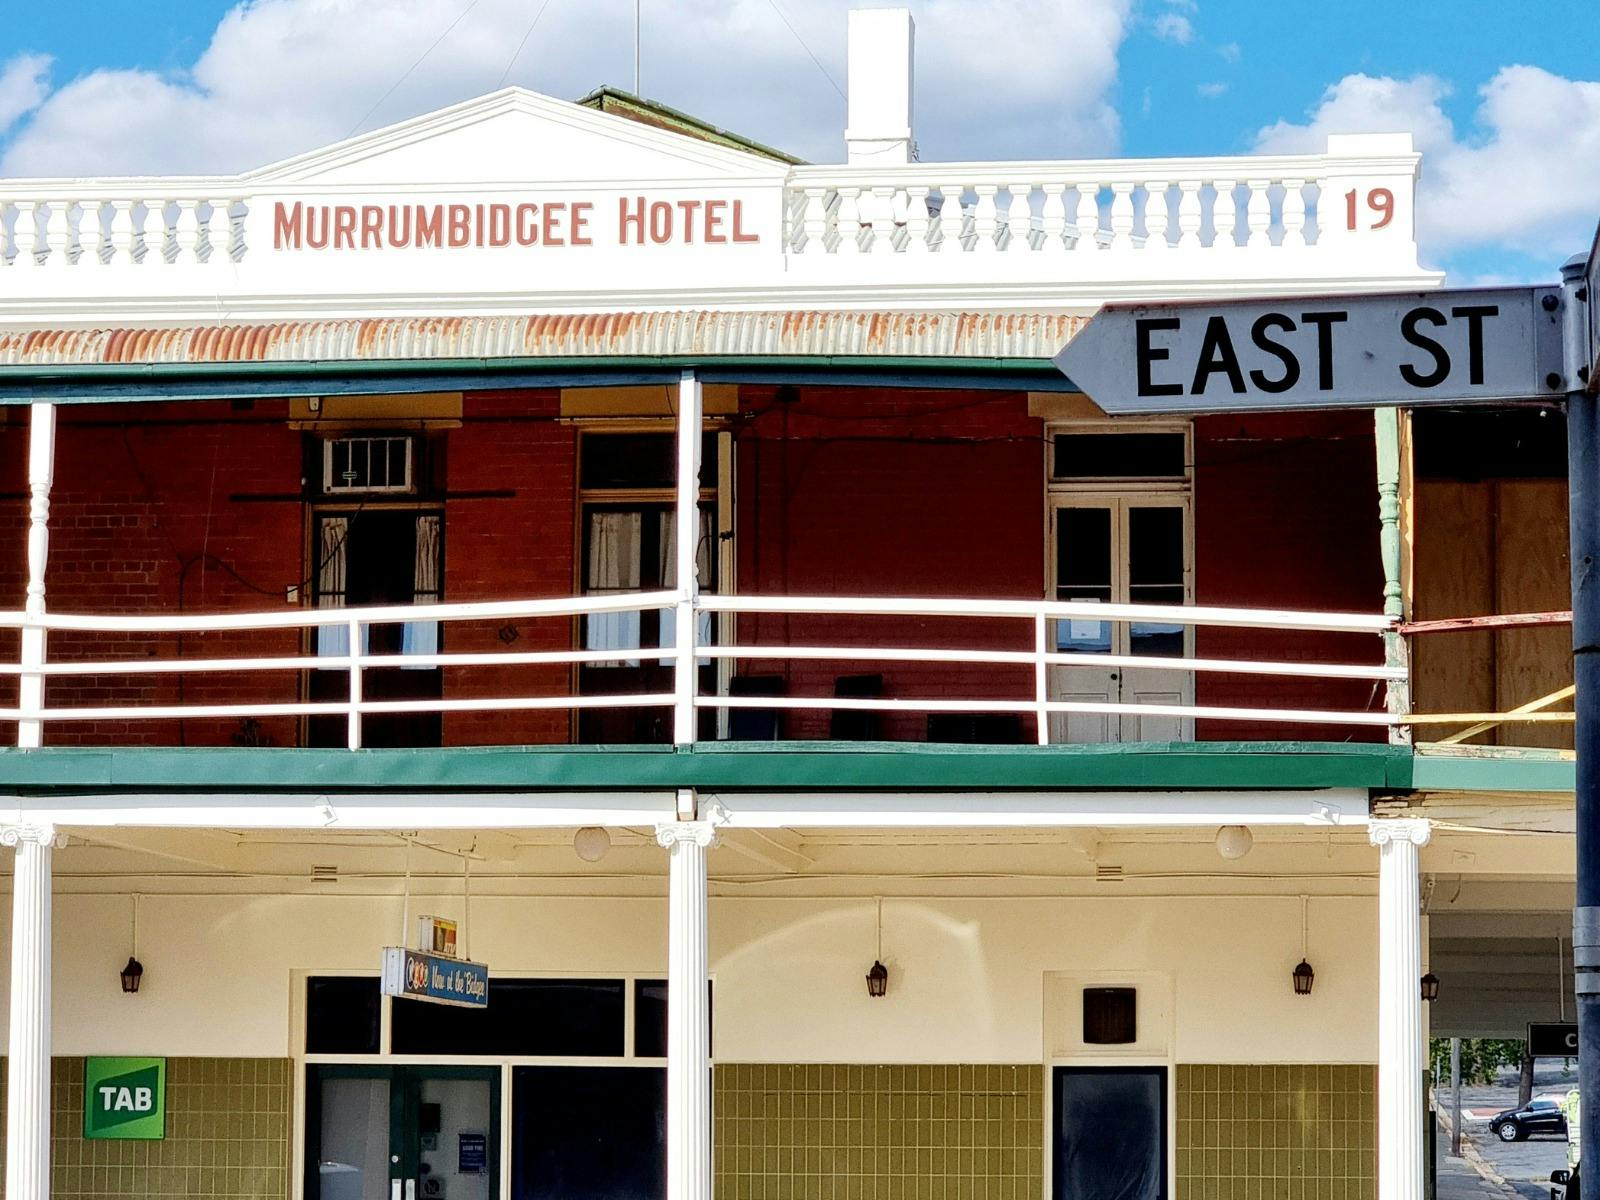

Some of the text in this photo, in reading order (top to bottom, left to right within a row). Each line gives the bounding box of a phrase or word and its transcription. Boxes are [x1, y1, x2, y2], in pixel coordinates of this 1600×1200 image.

[273, 196, 760, 250] MURRUMBIDGEE HOTEL
[1345, 187, 1395, 231] 19
[1135, 305, 1499, 397] EAST ST
[455, 969, 464, 993] the
[99, 1087, 152, 1111] TAB
